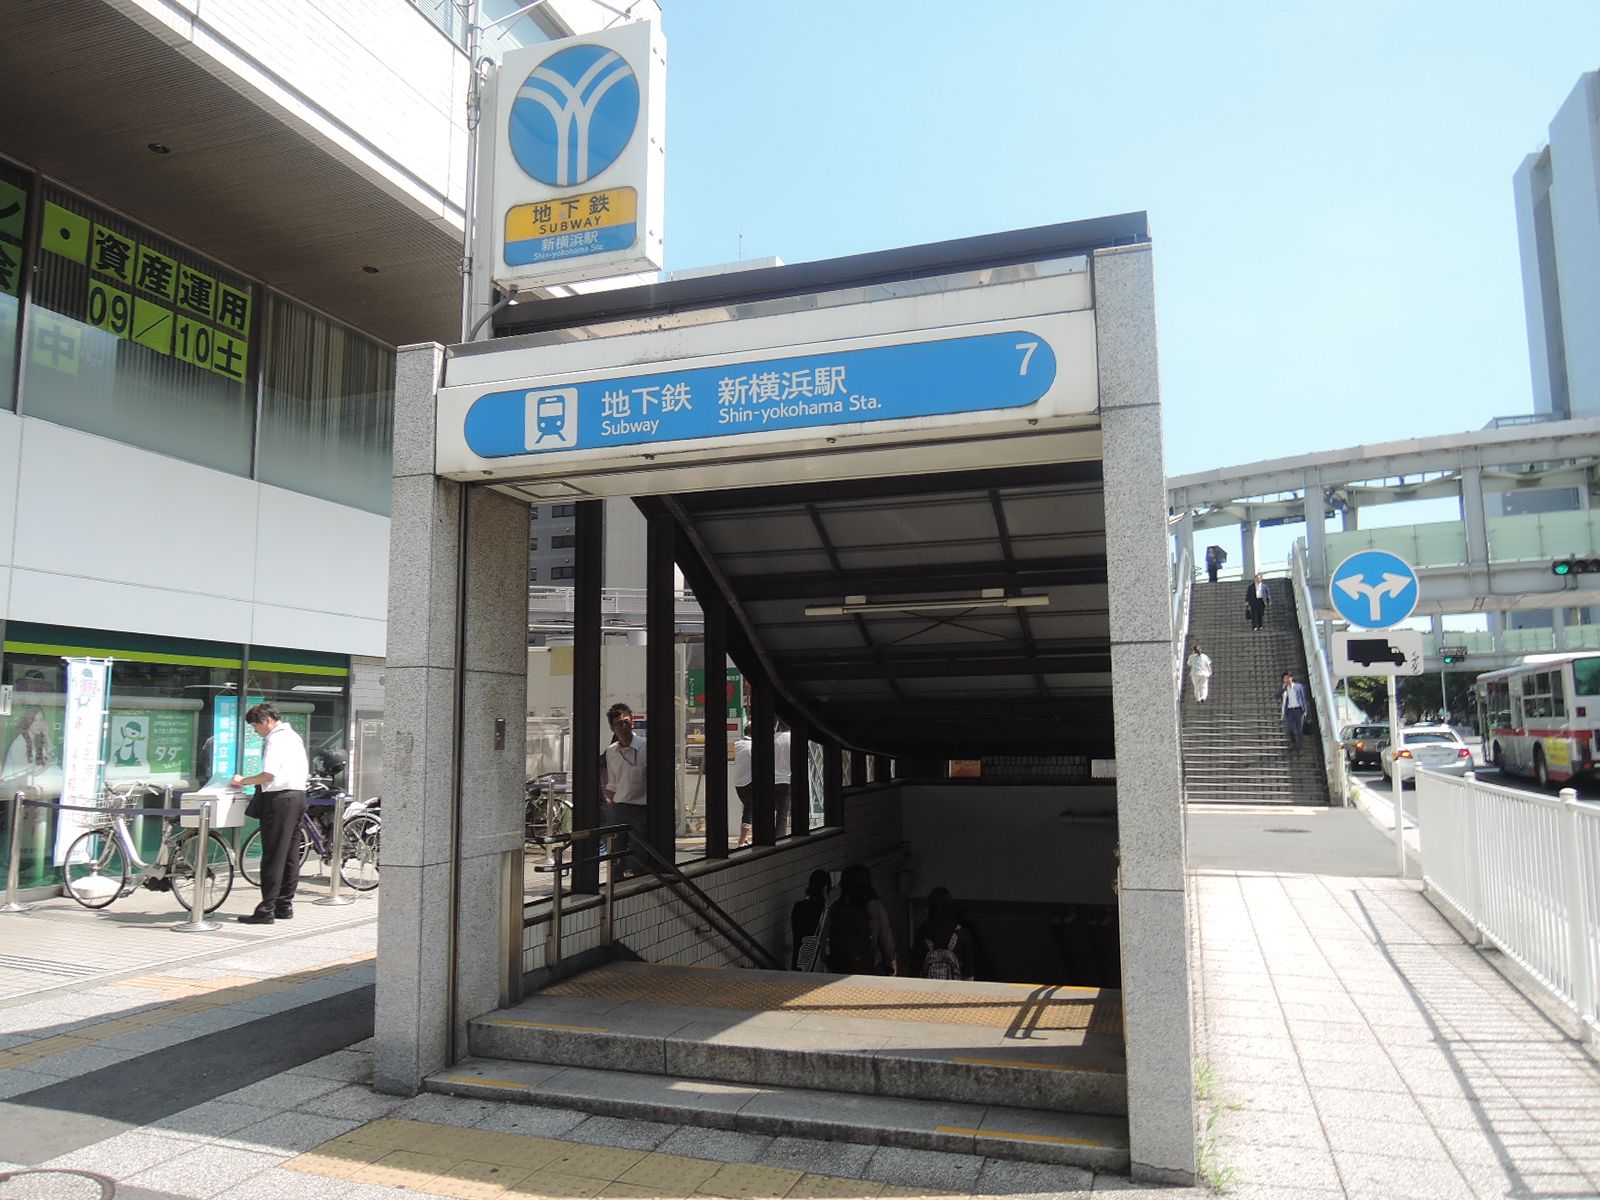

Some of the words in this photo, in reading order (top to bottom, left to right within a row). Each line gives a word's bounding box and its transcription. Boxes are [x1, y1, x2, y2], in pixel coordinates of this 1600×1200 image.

[532, 195, 610, 225] 地下鉄
[539, 215, 602, 235] SUBWAY
[541, 229, 599, 252] 新横浜駅
[38, 324, 75, 367] 中
[1015, 341, 1038, 376] 7
[601, 382, 693, 418] 地下鉄
[718, 365, 848, 407] 新横浜駅
[602, 418, 660, 437] Subway
[718, 400, 843, 425] Shin-yokohama
[850, 394, 882, 412] Sta.
